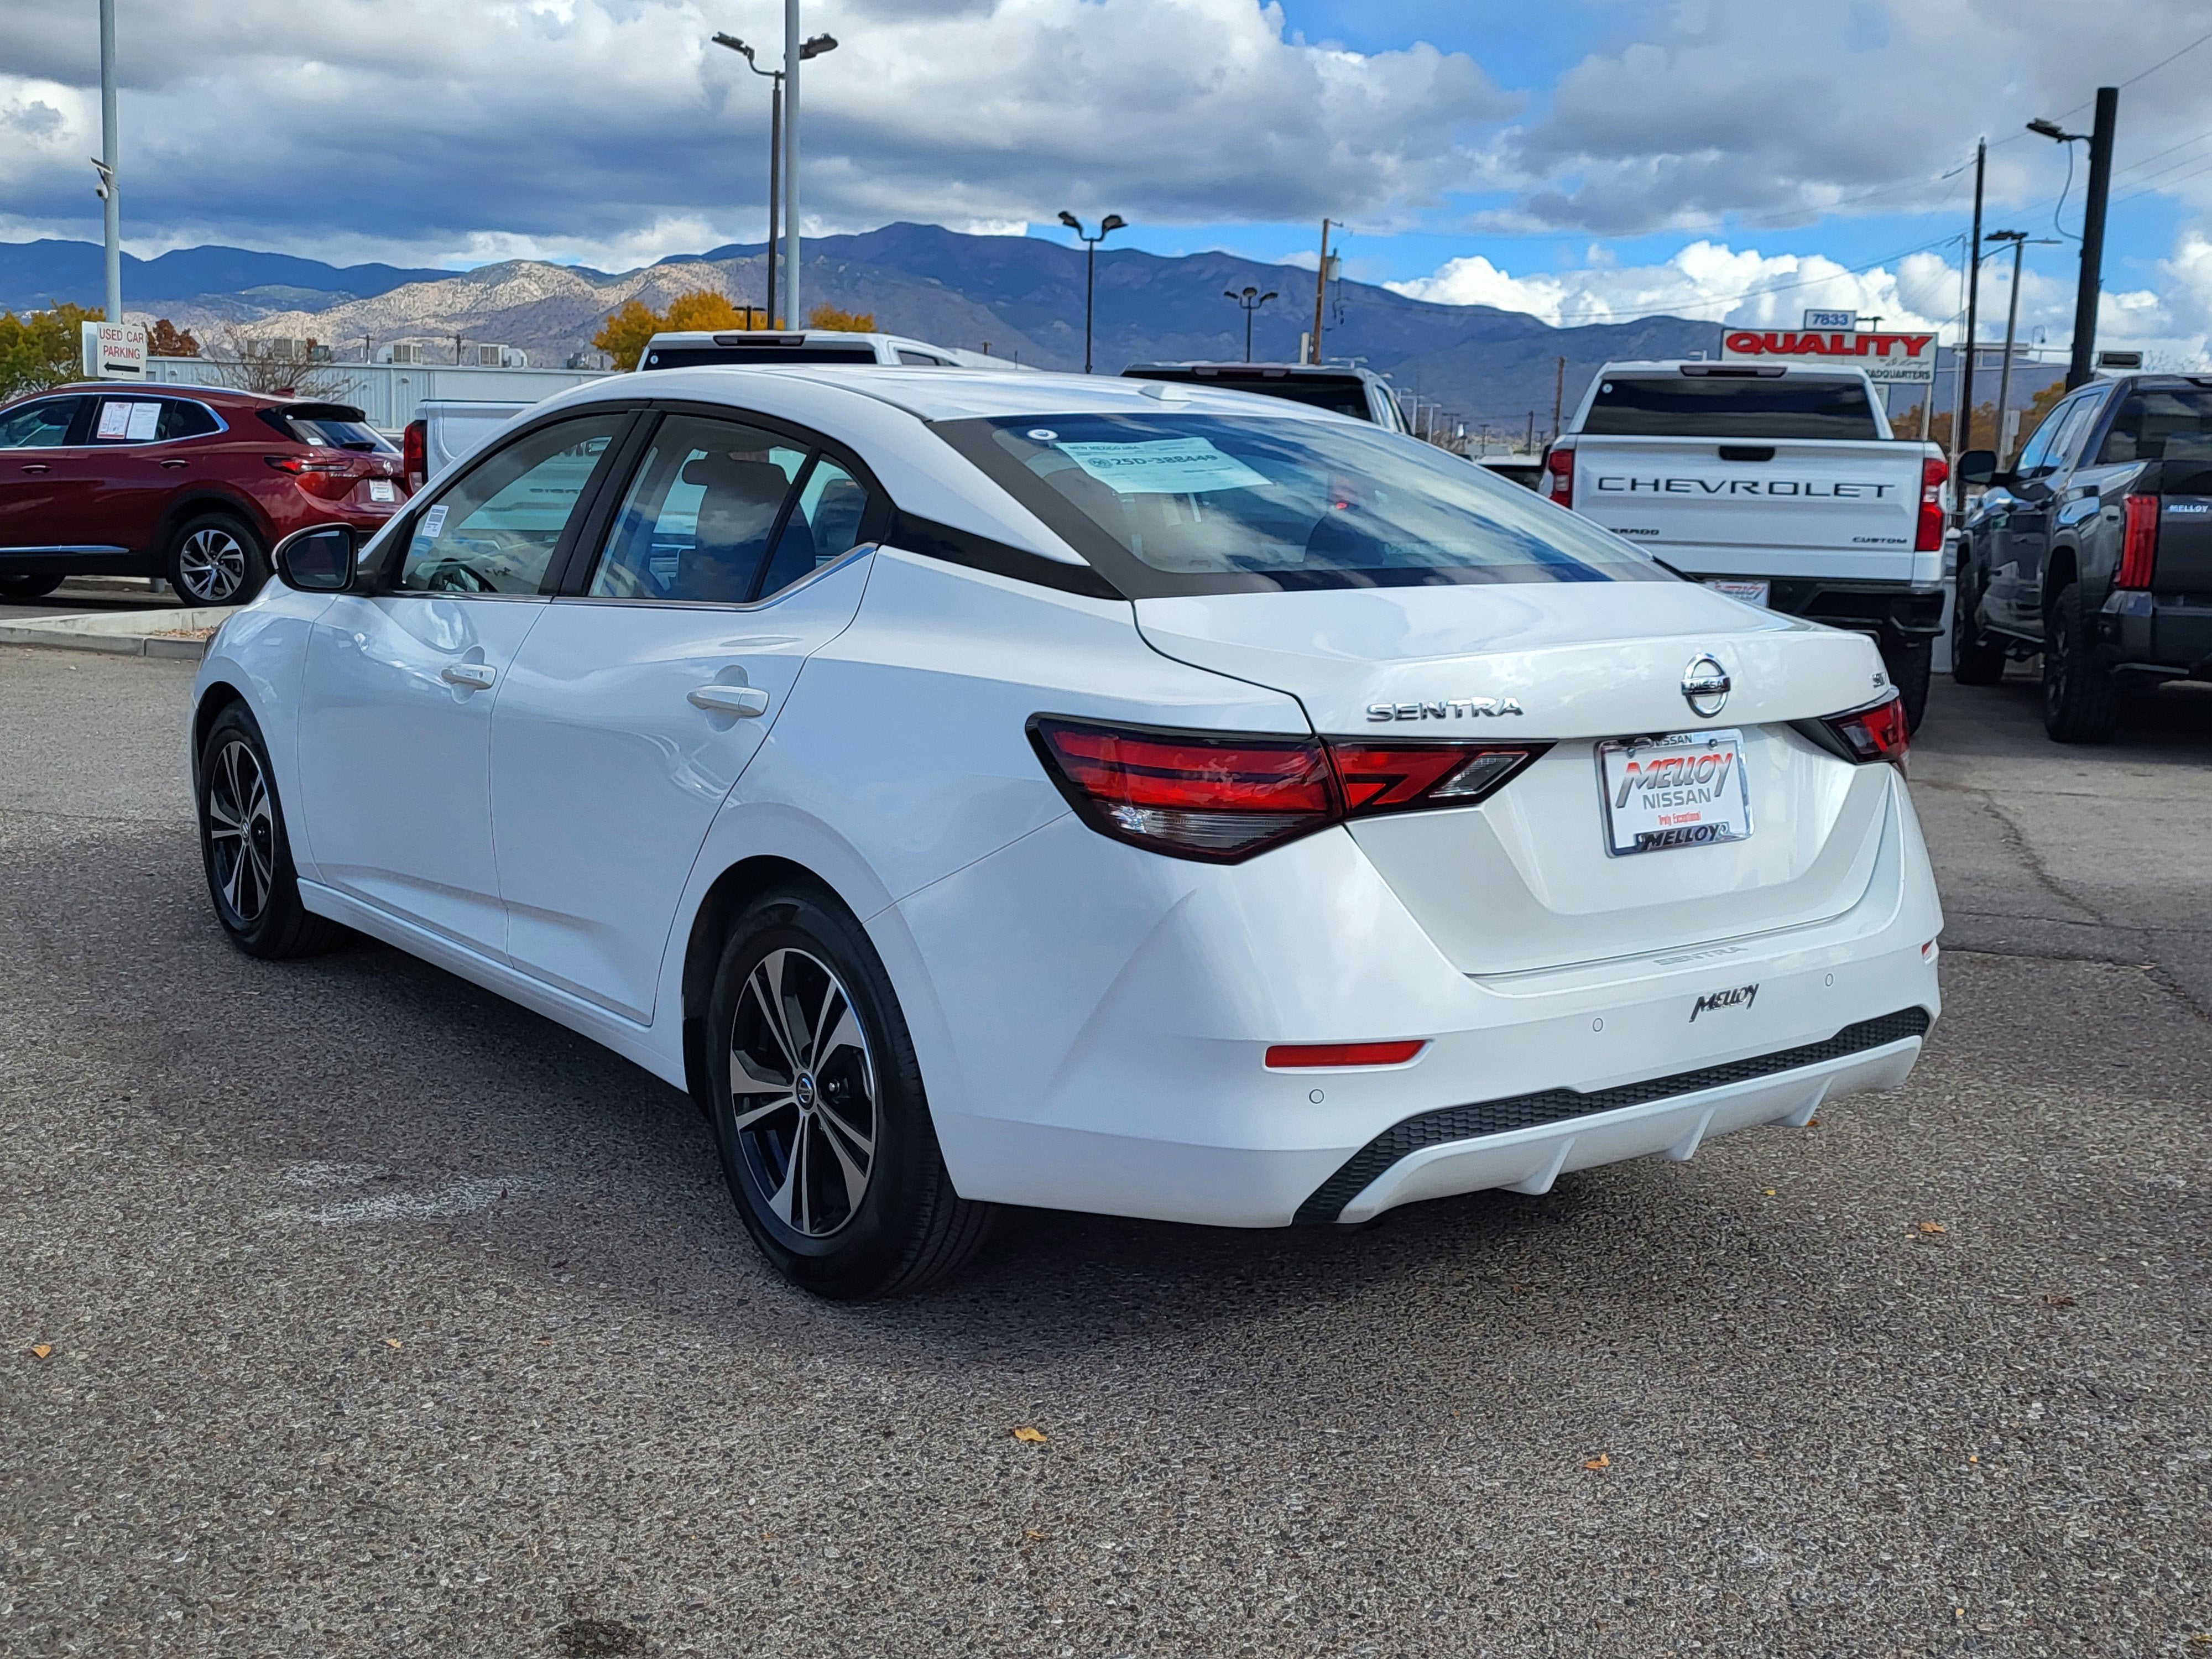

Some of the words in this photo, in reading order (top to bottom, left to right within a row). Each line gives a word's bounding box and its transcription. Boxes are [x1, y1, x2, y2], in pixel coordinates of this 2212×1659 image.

[1812, 314, 1849, 326] 7833
[100, 328, 123, 341] USED
[127, 331, 144, 343] CAR
[1725, 332, 1933, 357] QUALITY
[103, 345, 140, 359] PARKING
[1598, 477, 1895, 498] CHEVROLET
[1366, 697, 1525, 722] SENTRA
[1615, 753, 1733, 809] MELLOY
[1642, 787, 1712, 810] NISSAN
[1641, 824, 1721, 851] MELLOY
[1688, 983, 1760, 1023] MELLOY
